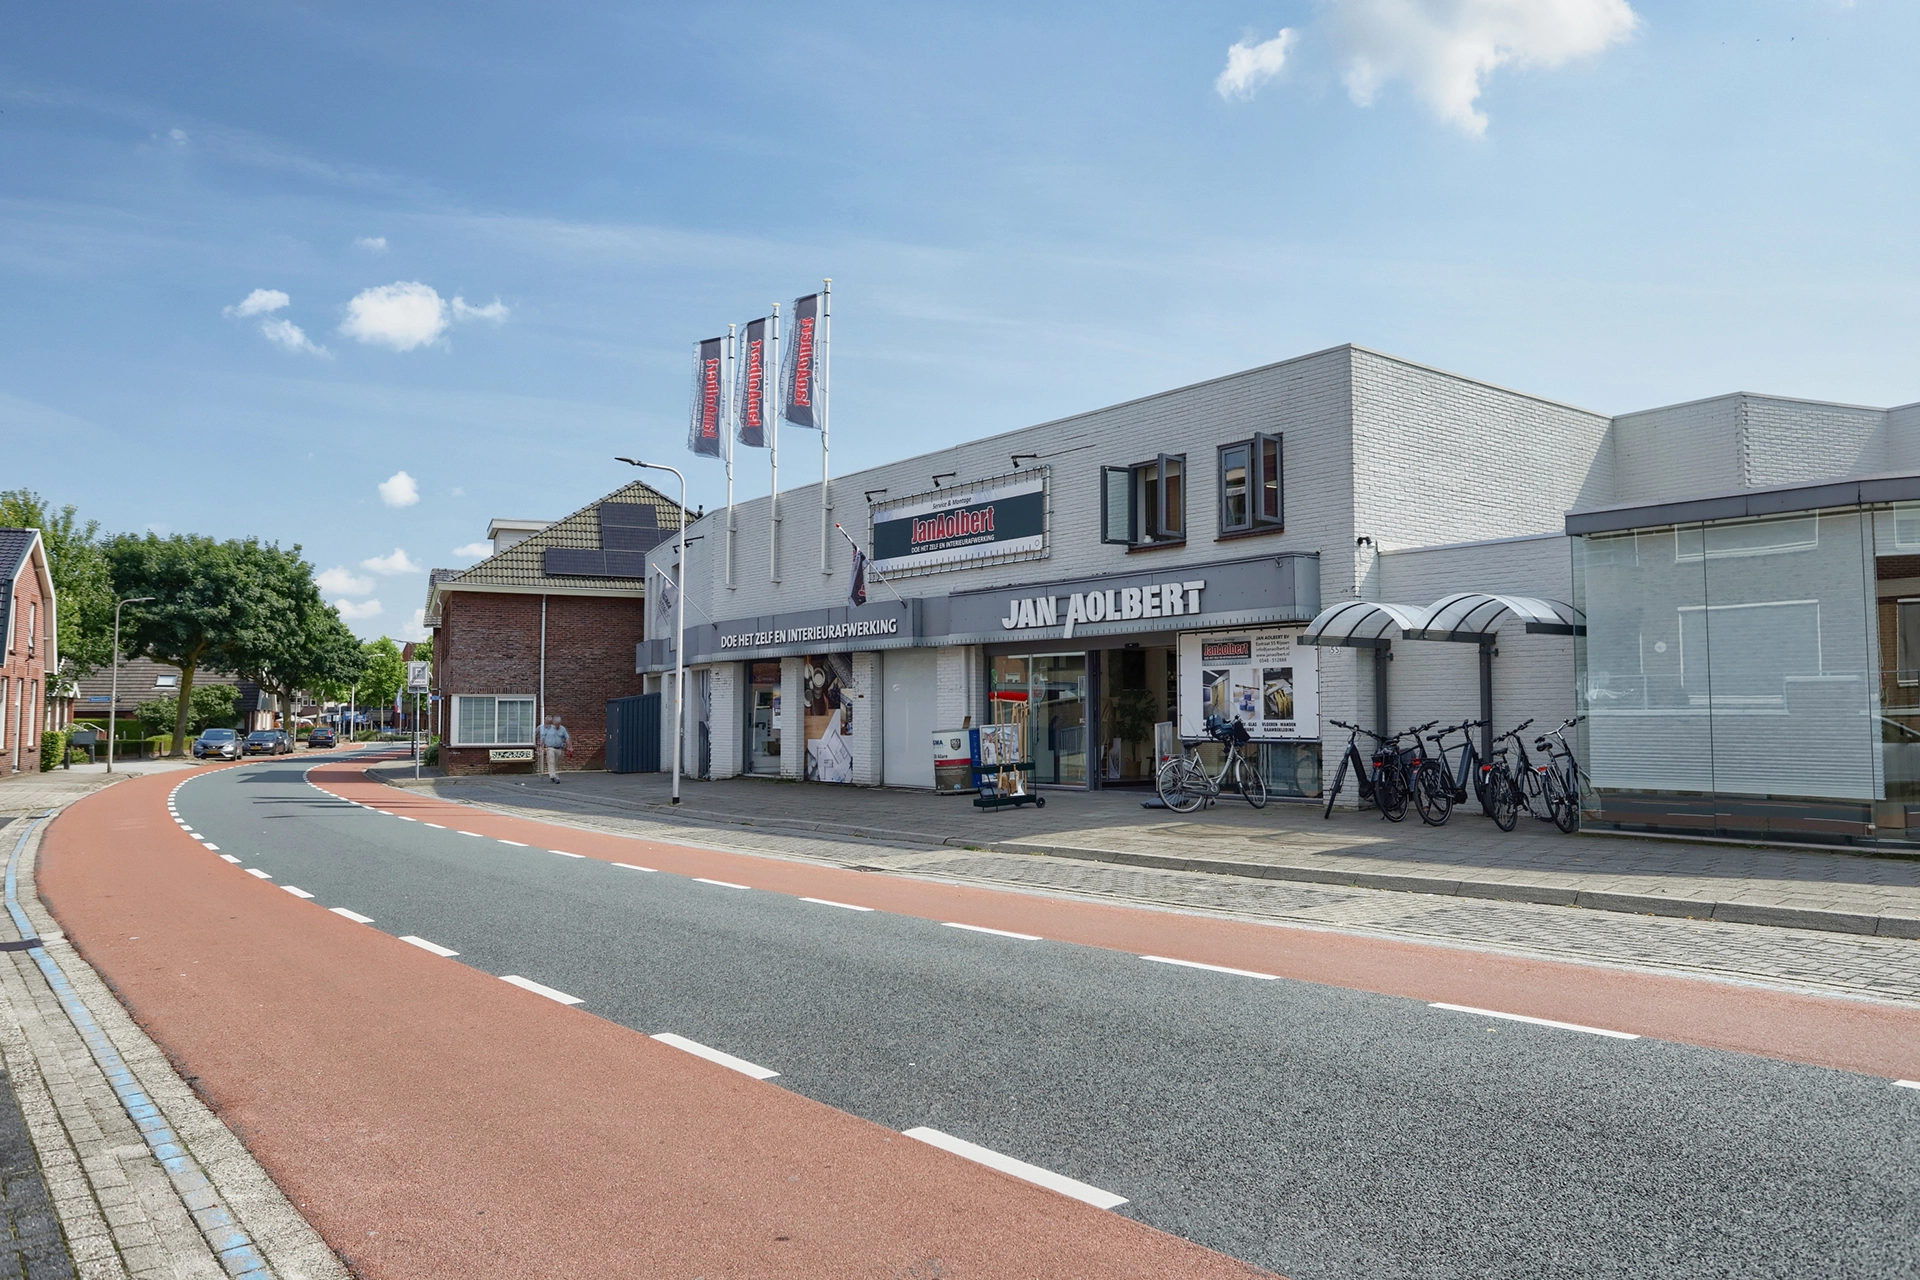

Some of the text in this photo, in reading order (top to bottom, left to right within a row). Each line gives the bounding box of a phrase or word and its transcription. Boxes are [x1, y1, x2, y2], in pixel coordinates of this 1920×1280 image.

[932, 502, 947, 510] Service
[952, 497, 972, 506] Montage
[911, 505, 995, 544] JanAolbert
[911, 546, 921, 554] DOE
[929, 543, 939, 551] ZELF
[946, 534, 995, 548] INTERIEURAFWERKING
[1001, 579, 1206, 639] JAN AOLBERT
[721, 618, 897, 649] DOE HET ZELF EN INTERIEURAFWERKING
[1203, 642, 1249, 656] JanAolbert
